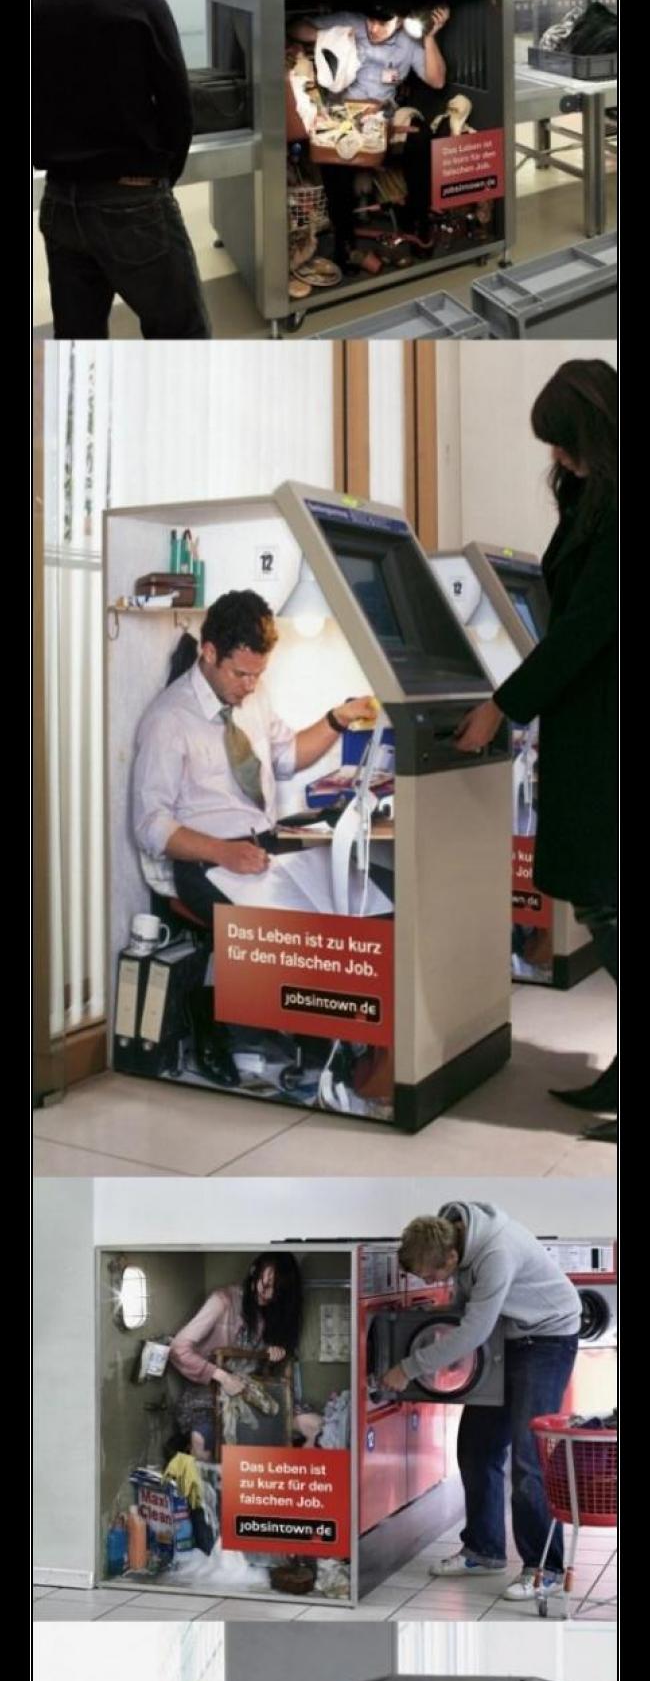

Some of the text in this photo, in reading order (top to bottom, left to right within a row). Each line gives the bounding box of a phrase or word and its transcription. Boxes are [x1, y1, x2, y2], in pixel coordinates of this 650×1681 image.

[260, 554, 274, 571] 12
[228, 923, 382, 954] Das Leben ist zu kurz
[228, 946, 378, 977] für den falschen Job.
[240, 1461, 326, 1475] Das Leben ist
[240, 1478, 333, 1492] zu kurz für den
[240, 1492, 324, 1509] falschen Job.
